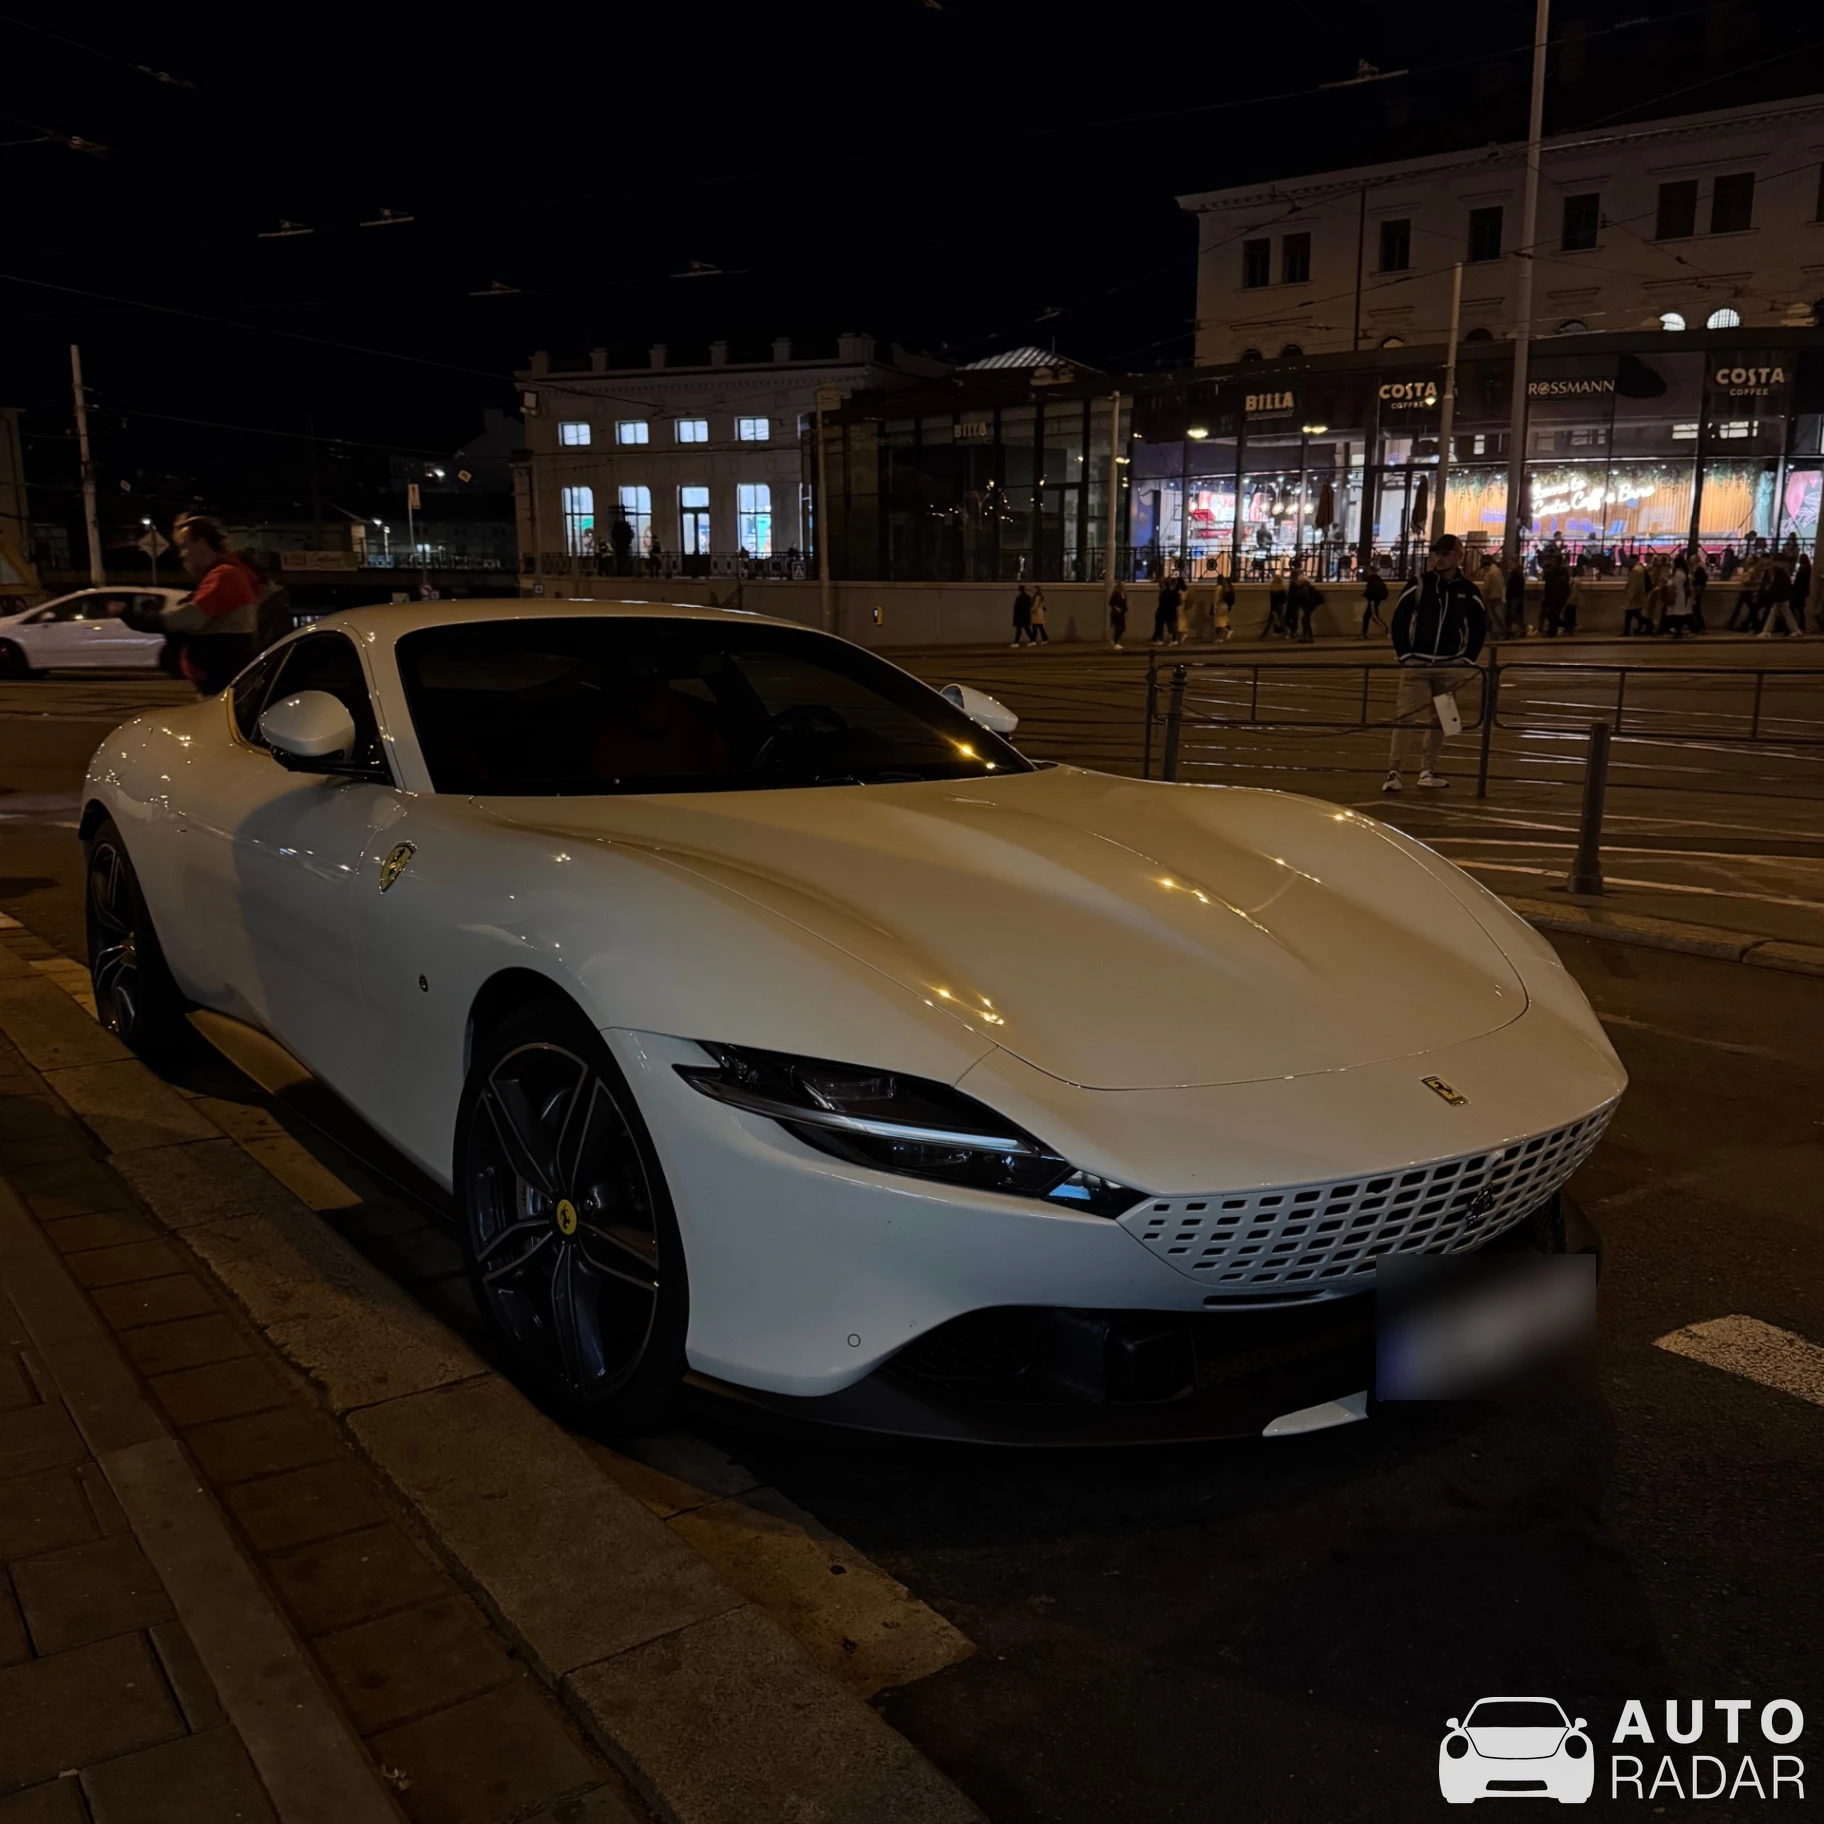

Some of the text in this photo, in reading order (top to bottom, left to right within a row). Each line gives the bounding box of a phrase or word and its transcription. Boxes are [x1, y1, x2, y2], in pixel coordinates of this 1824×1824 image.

[1714, 367, 1785, 387] COSTA
[1379, 381, 1438, 400] COSTA
[1527, 379, 1616, 396] ROSSMANN
[1729, 387, 1769, 397] COFFEE
[1245, 391, 1294, 412] BILLA
[1390, 401, 1425, 410] COFFEE
